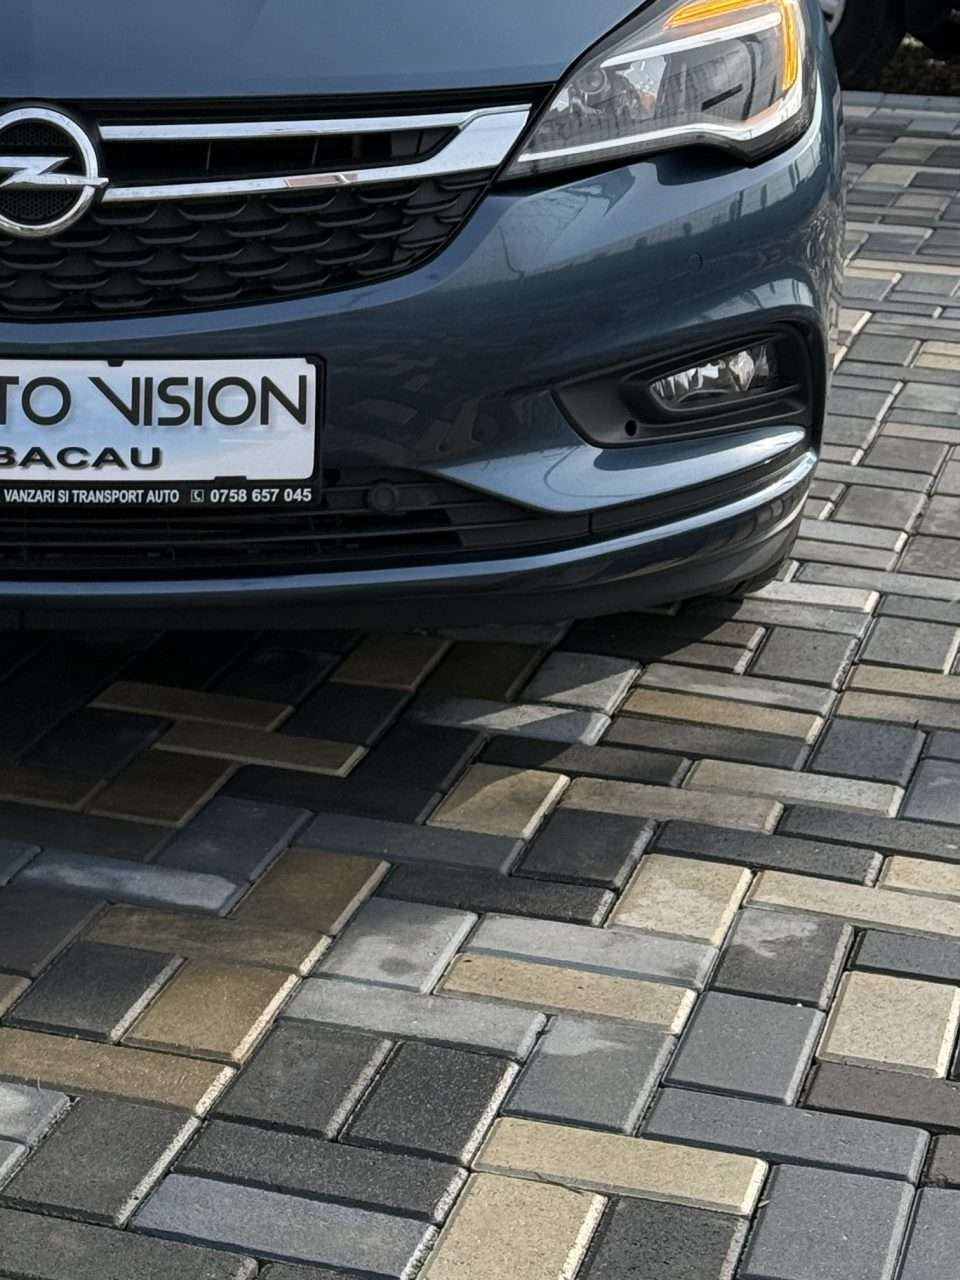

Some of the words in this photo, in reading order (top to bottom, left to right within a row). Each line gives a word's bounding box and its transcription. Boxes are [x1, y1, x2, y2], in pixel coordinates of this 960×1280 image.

[88, 375, 307, 426] VISION
[4, 488, 54, 503] VANZARI
[58, 489, 69, 503] SI
[72, 489, 143, 504] TRANSPORT
[146, 489, 180, 504] AUTO
[210, 488, 247, 503] 0758
[252, 488, 279, 502] 657
[283, 488, 312, 502] 045
